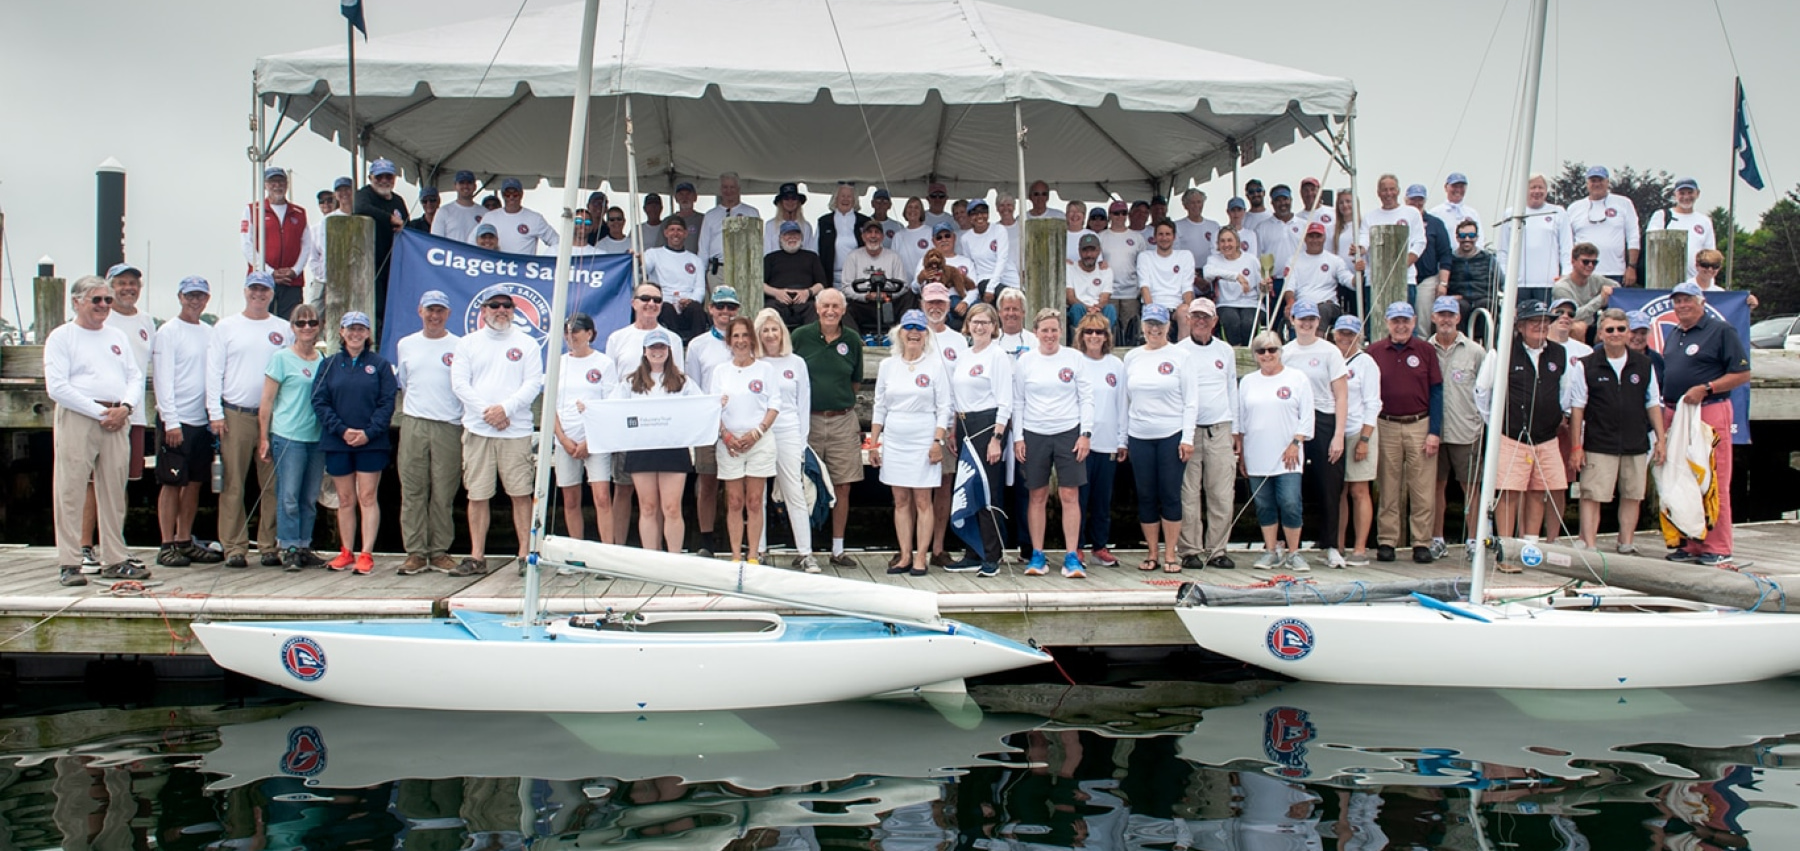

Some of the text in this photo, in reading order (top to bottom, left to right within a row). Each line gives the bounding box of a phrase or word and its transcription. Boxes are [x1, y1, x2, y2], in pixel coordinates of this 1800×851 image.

[426, 248, 605, 288] Clagett Saing
[517, 287, 548, 315] SAILING
